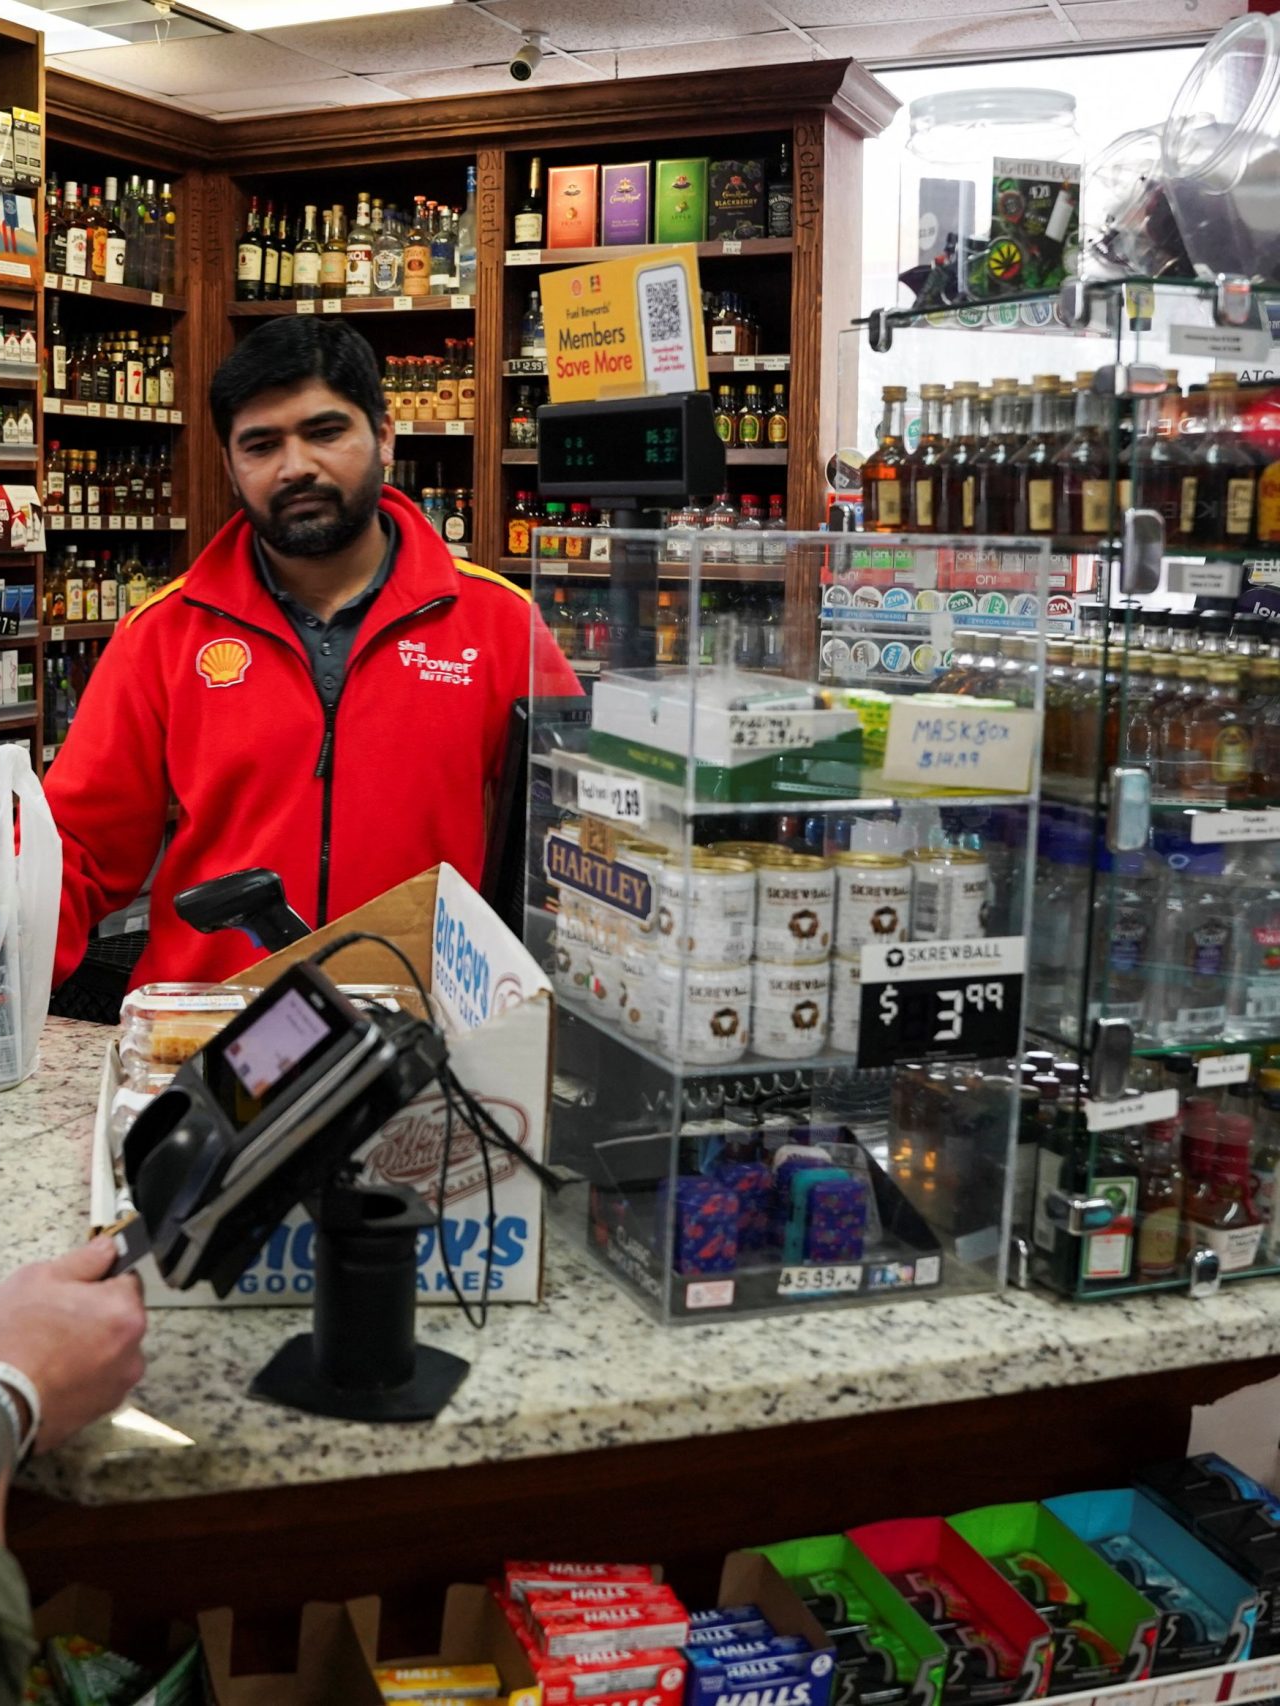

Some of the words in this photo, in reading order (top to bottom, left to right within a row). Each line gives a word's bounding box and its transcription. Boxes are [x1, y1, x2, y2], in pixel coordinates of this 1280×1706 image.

[558, 322, 626, 352] Members
[556, 356, 590, 380] Save
[594, 350, 633, 374] More
[886, 593, 904, 604] ZYN
[950, 598, 969, 609] ZYN
[1048, 602, 1068, 612] ZYN
[398, 640, 426, 652] Shell
[398, 652, 472, 674] V-Power
[551, 842, 648, 911] HARTLEY
[435, 896, 455, 970] BIG
[455, 920, 490, 1020] BOY'S
[907, 943, 1002, 963] SKREWBALL
[415, 1270, 504, 1291] AKES
[549, 1562, 608, 1575] HALLS
[572, 1586, 628, 1601] HALLS
[584, 1608, 643, 1622] HALLS
[712, 1640, 766, 1658] HALLS
[576, 1650, 633, 1666] HALLS
[394, 1667, 453, 1682] HALLS
[726, 1660, 780, 1678] HALLS
